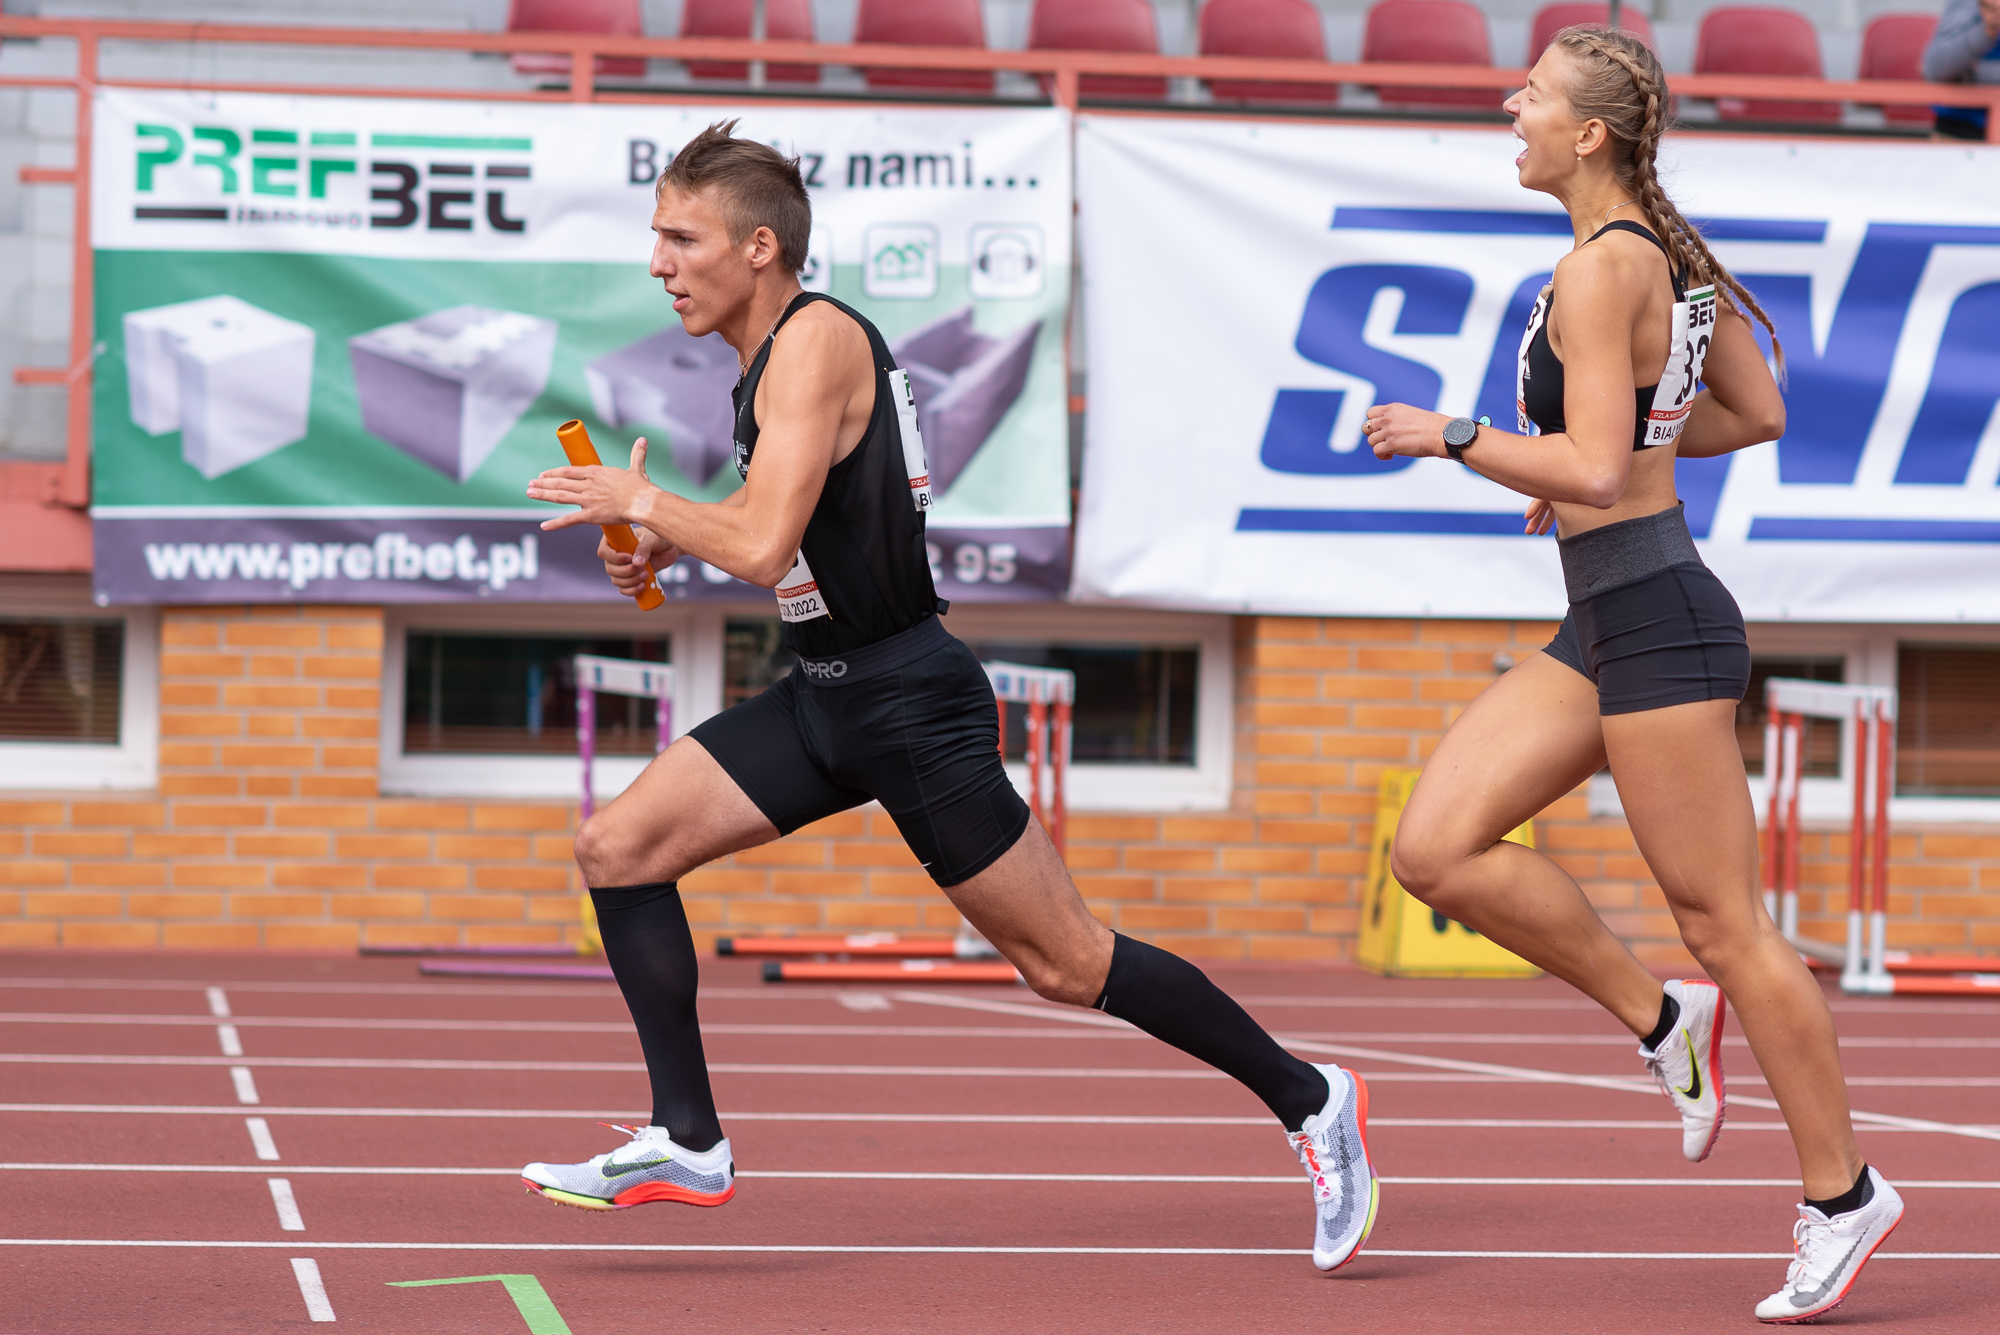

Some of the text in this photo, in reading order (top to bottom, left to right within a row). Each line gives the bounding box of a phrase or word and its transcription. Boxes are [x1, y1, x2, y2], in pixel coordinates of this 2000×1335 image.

[846, 142, 1039, 188] nami...
[144, 532, 538, 591] www.prefbet.pl
[954, 541, 1017, 584] 95
[791, 597, 819, 617] 2022
